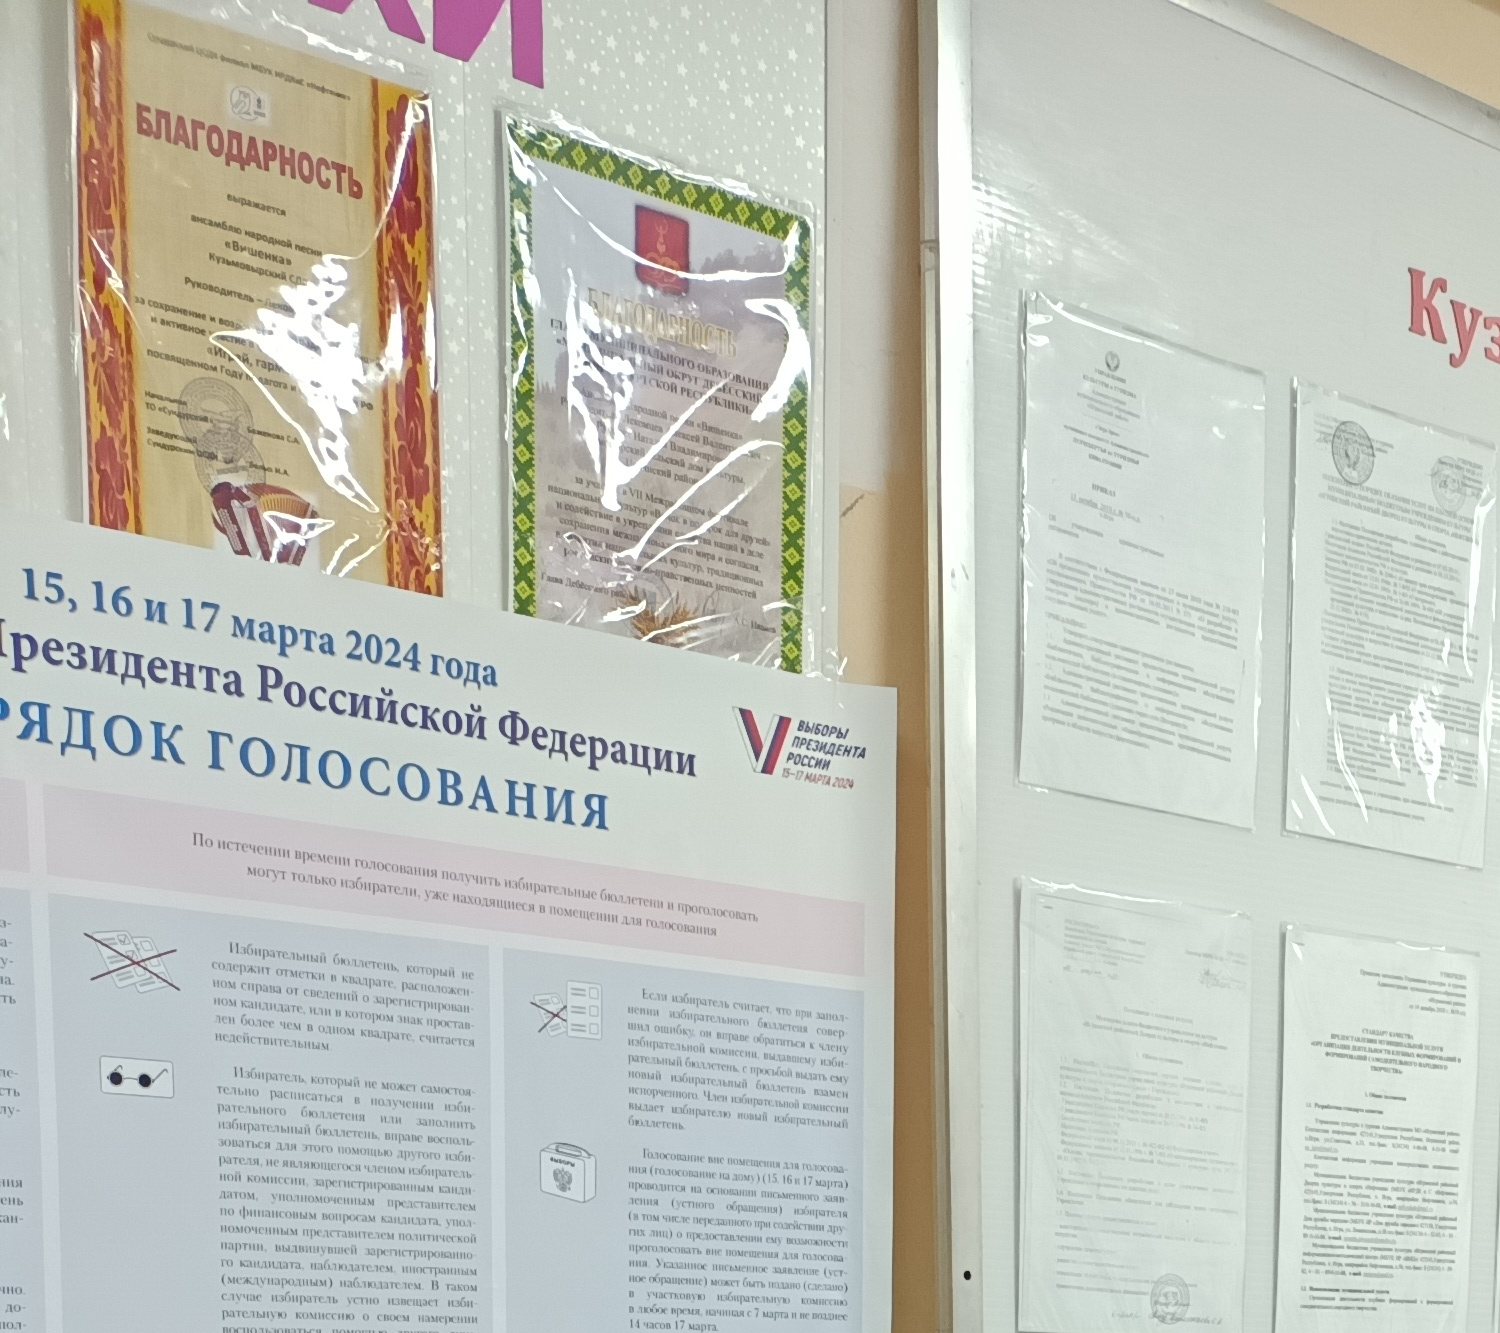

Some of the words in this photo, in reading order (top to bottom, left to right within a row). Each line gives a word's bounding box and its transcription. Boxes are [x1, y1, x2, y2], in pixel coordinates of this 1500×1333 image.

[136, 101, 363, 200] БЛАГОДАРНОСТЬ
[226, 194, 286, 217] выражается
[191, 213, 242, 235] ансамблю
[244, 230, 292, 250] народной
[294, 242, 322, 258] песни
[208, 252, 287, 282] Кузьмовырский
[224, 239, 292, 266] «Вишенка»
[184, 276, 254, 303] Руководитель
[134, 296, 145, 306] за
[148, 299, 206, 322] сохранение
[210, 315, 216, 324] и
[588, 287, 737, 359] БЛАГОДАРНОСТЬ
[151, 316, 158, 324] и
[160, 319, 206, 336] активное
[147, 349, 218, 373] посвященном
[220, 364, 244, 380] Году
[666, 369, 700, 387] ОКРУГ
[698, 363, 769, 391] ОБРАЗОВАНИЯ
[144, 402, 156, 411] ТО
[247, 426, 285, 442] Баженова
[560, 518, 610, 536] сохранения
[564, 504, 614, 522] содействие
[670, 556, 705, 573] культур,
[706, 566, 764, 588] традиционных
[696, 550, 716, 562] мира
[725, 557, 761, 574] согласия,
[716, 584, 757, 600] ценностей
[21, 568, 78, 613] 15,
[92, 579, 134, 618] 16
[144, 596, 168, 625] и
[182, 593, 221, 633] 17
[230, 610, 336, 662] марта
[344, 630, 422, 673] 2024
[429, 655, 500, 688] года
[257, 664, 488, 740] Российской
[499, 709, 698, 779] Федерации
[797, 720, 850, 740] ВЫБОРЫ
[786, 752, 832, 771] РОССИИ
[792, 735, 867, 760] ПРЕЗИДЕНТА
[208, 730, 611, 832] ГОЛОСОВАНИЯ
[804, 770, 831, 786] МАРТА
[832, 776, 855, 790] 2024
[192, 832, 214, 848] По
[217, 840, 291, 858] истечении
[294, 850, 351, 866] времени
[354, 858, 438, 878] голосования
[441, 870, 501, 886] получить
[504, 876, 598, 900] избирательные
[600, 888, 664, 908] бюллетени
[668, 902, 675, 910] и
[677, 902, 759, 922] проголосовать
[246, 866, 288, 882] могут
[290, 872, 337, 886] только
[340, 876, 421, 900] избиратели,
[424, 890, 449, 902] уже
[452, 892, 536, 912] находящиеся
[538, 904, 546, 914] в
[549, 906, 619, 924] помещении
[622, 916, 643, 926] для
[645, 918, 718, 936] голосования
[228, 942, 327, 964] Избирательный
[406, 964, 456, 978] который
[460, 970, 475, 980] не
[211, 960, 272, 976] содержит
[275, 968, 326, 982] отметки
[330, 974, 337, 982] в
[401, 982, 475, 996] расположен-
[212, 978, 236, 990] ном
[240, 982, 282, 996] справа
[286, 986, 300, 996] от
[303, 988, 358, 1002] сведений
[362, 994, 369, 1002] о
[374, 996, 474, 1014] зарегистрирован-
[642, 988, 667, 1002] Если
[672, 992, 730, 1008] избиратель
[776, 1006, 792, 1016] что
[795, 1010, 812, 1020] при
[816, 1012, 849, 1022] запол-
[213, 998, 237, 1008] ном
[309, 1006, 332, 1016] или
[335, 1008, 342, 1018] в
[344, 1010, 394, 1024] котором
[397, 1014, 423, 1026] знак
[426, 1018, 475, 1030] простав-
[214, 1014, 236, 1024] лен
[240, 1014, 275, 1028] более
[279, 1020, 302, 1032] чем
[306, 1024, 314, 1032] в
[318, 1024, 355, 1036] одном
[419, 1034, 475, 1048] считается
